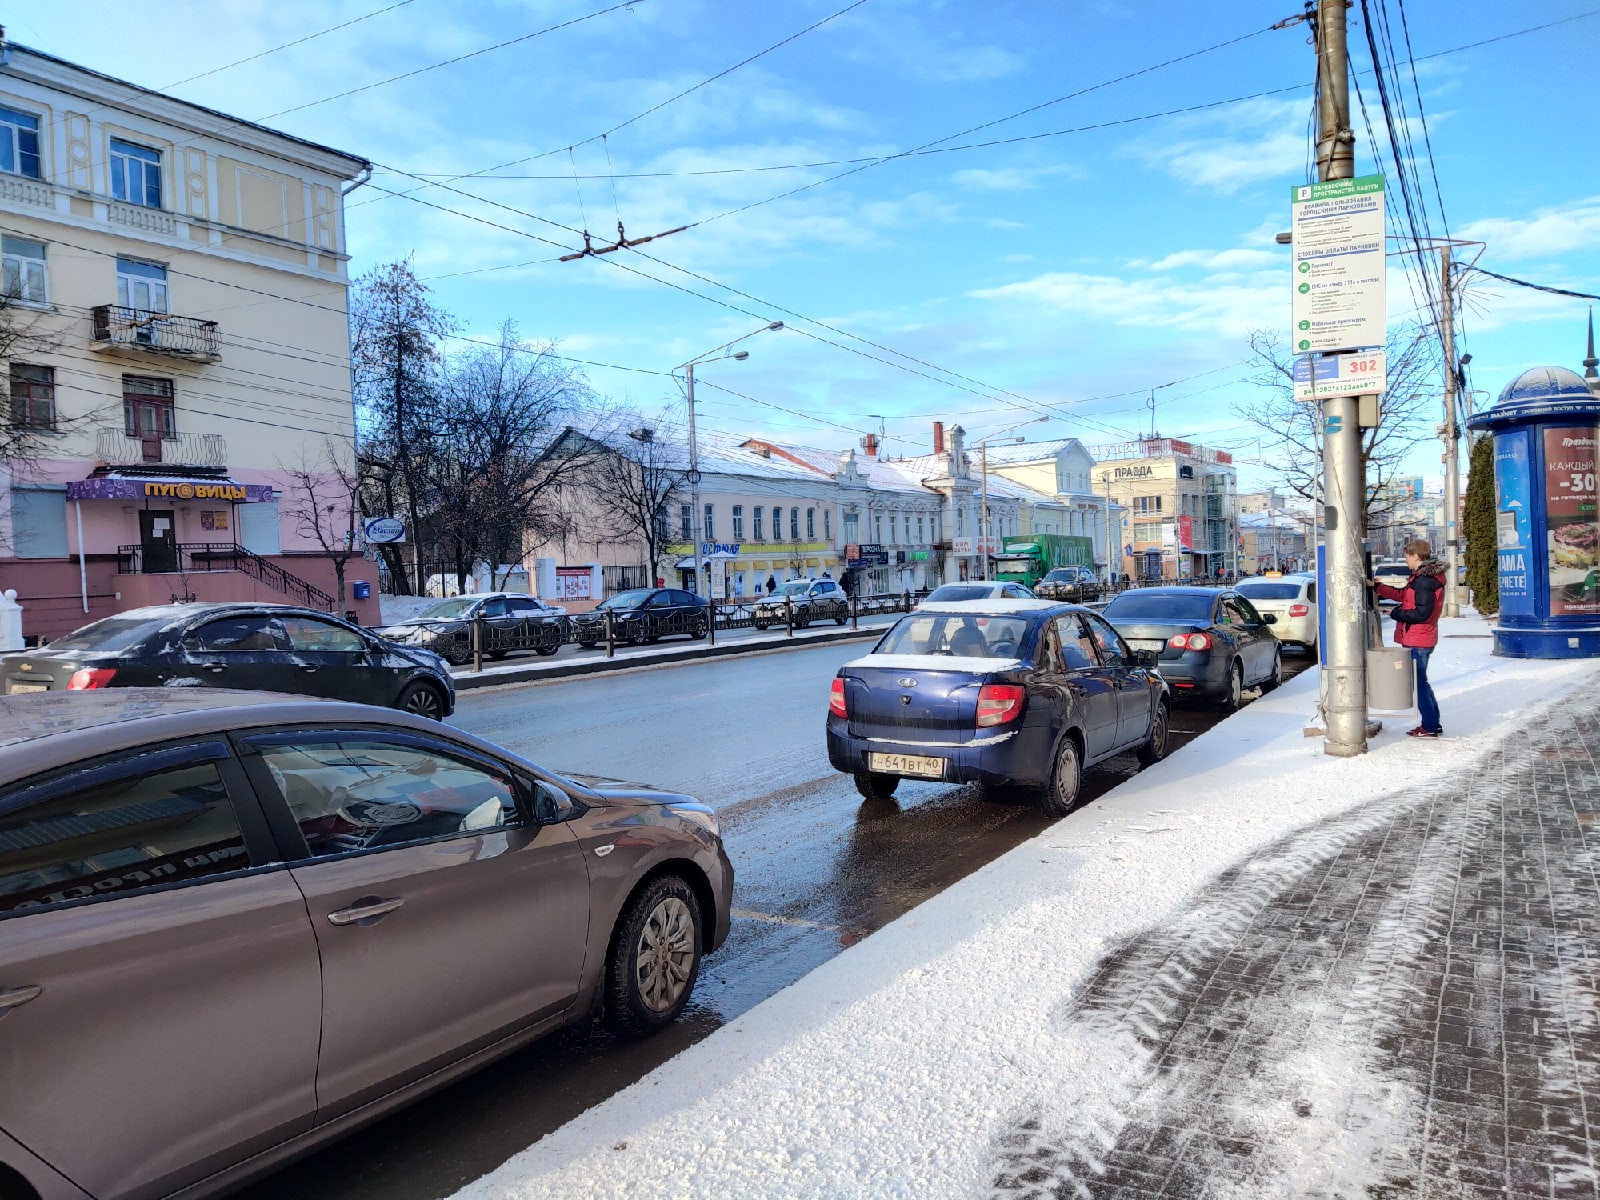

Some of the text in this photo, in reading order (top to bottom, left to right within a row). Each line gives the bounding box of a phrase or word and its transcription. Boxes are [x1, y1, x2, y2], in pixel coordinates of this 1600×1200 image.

[1349, 359, 1377, 374] 302
[1114, 465, 1153, 478] ПРАВДА
[1549, 461, 1595, 472] КАЖДЫЙ
[145, 482, 247, 500] ПУГОВИЦЫ
[1498, 553, 1526, 572] АМА
[877, 756, 939, 771] Н641ВТ 40
